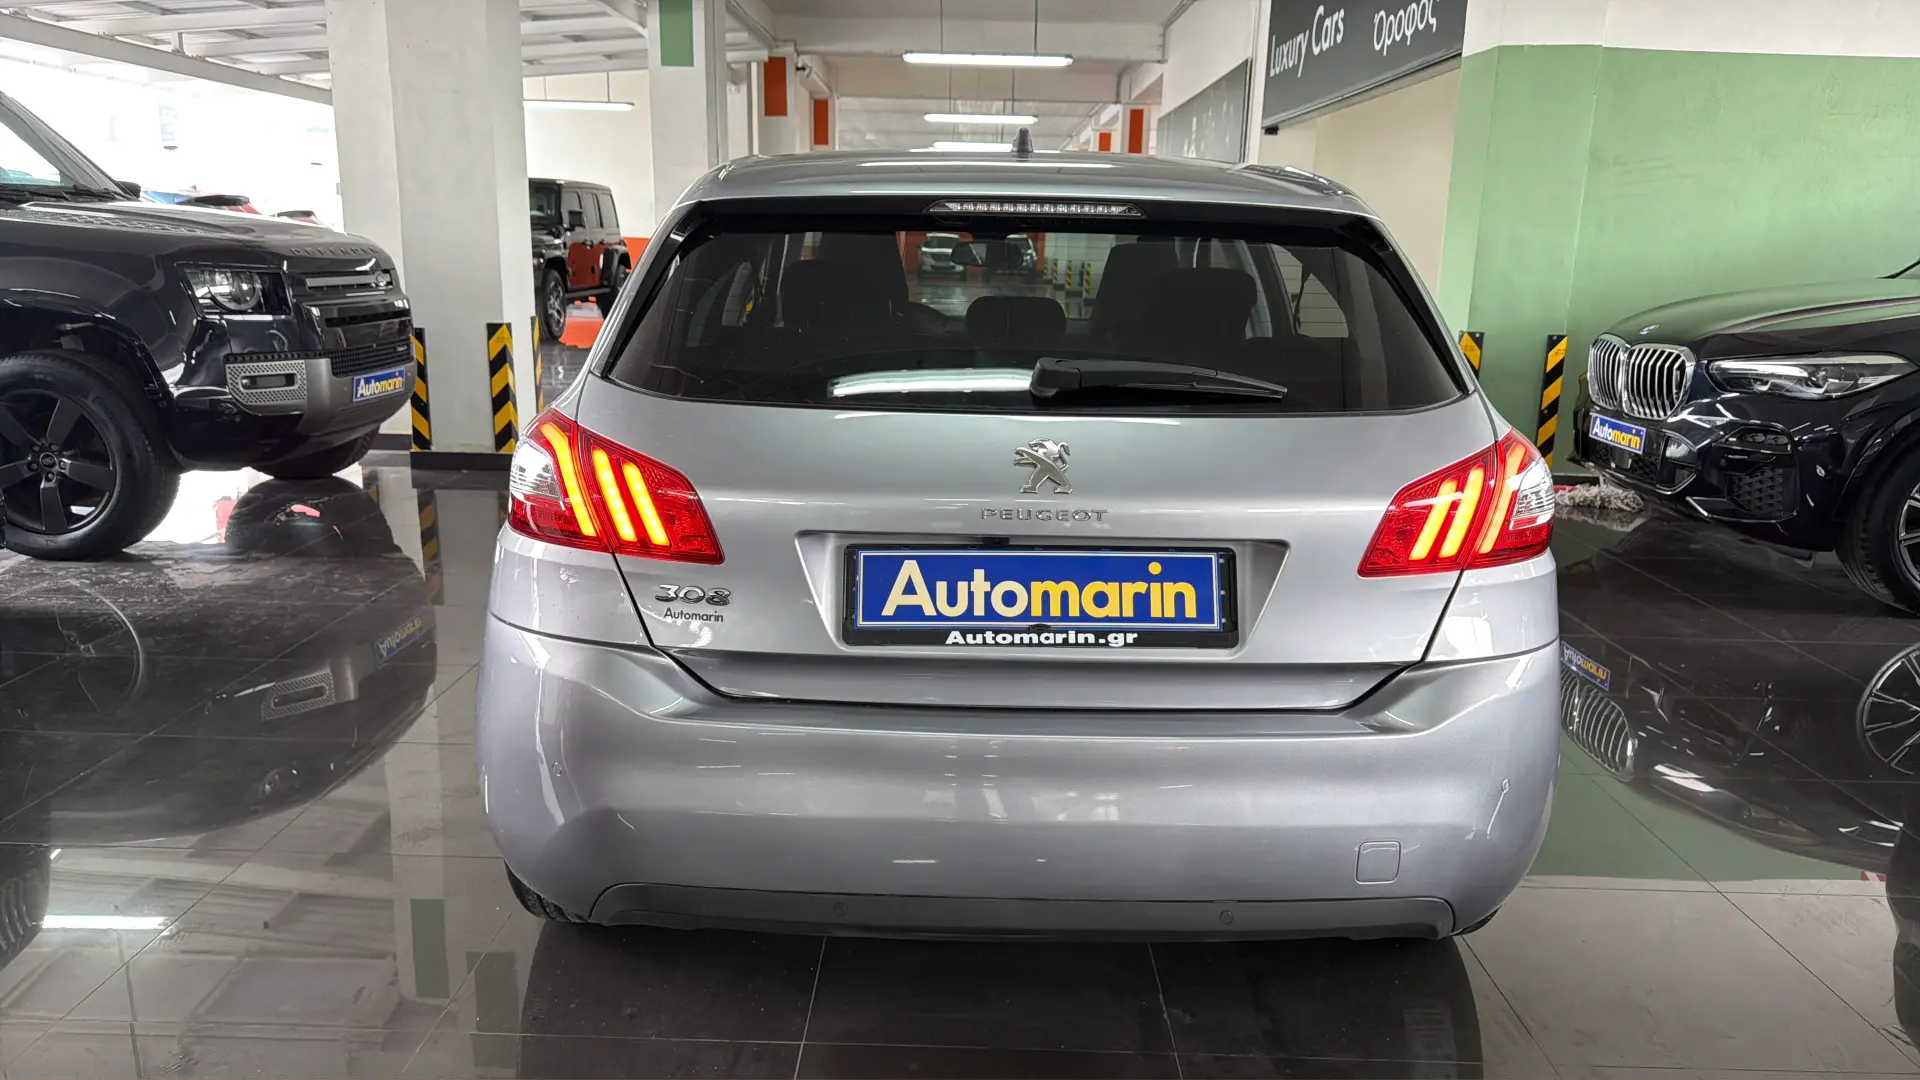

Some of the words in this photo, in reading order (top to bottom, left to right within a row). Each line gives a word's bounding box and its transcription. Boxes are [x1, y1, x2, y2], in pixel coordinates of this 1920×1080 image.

[1270, 29, 1310, 78] Luxury
[1312, 5, 1344, 55] Cars
[357, 371, 403, 398] Automarin
[1592, 418, 1641, 450] Automarin
[981, 508, 1109, 521] PEUGEOT
[655, 584, 732, 606] 308
[881, 559, 1197, 618] Automarin
[664, 607, 724, 622] Automarin
[945, 630, 1138, 647] Automarin.gr
